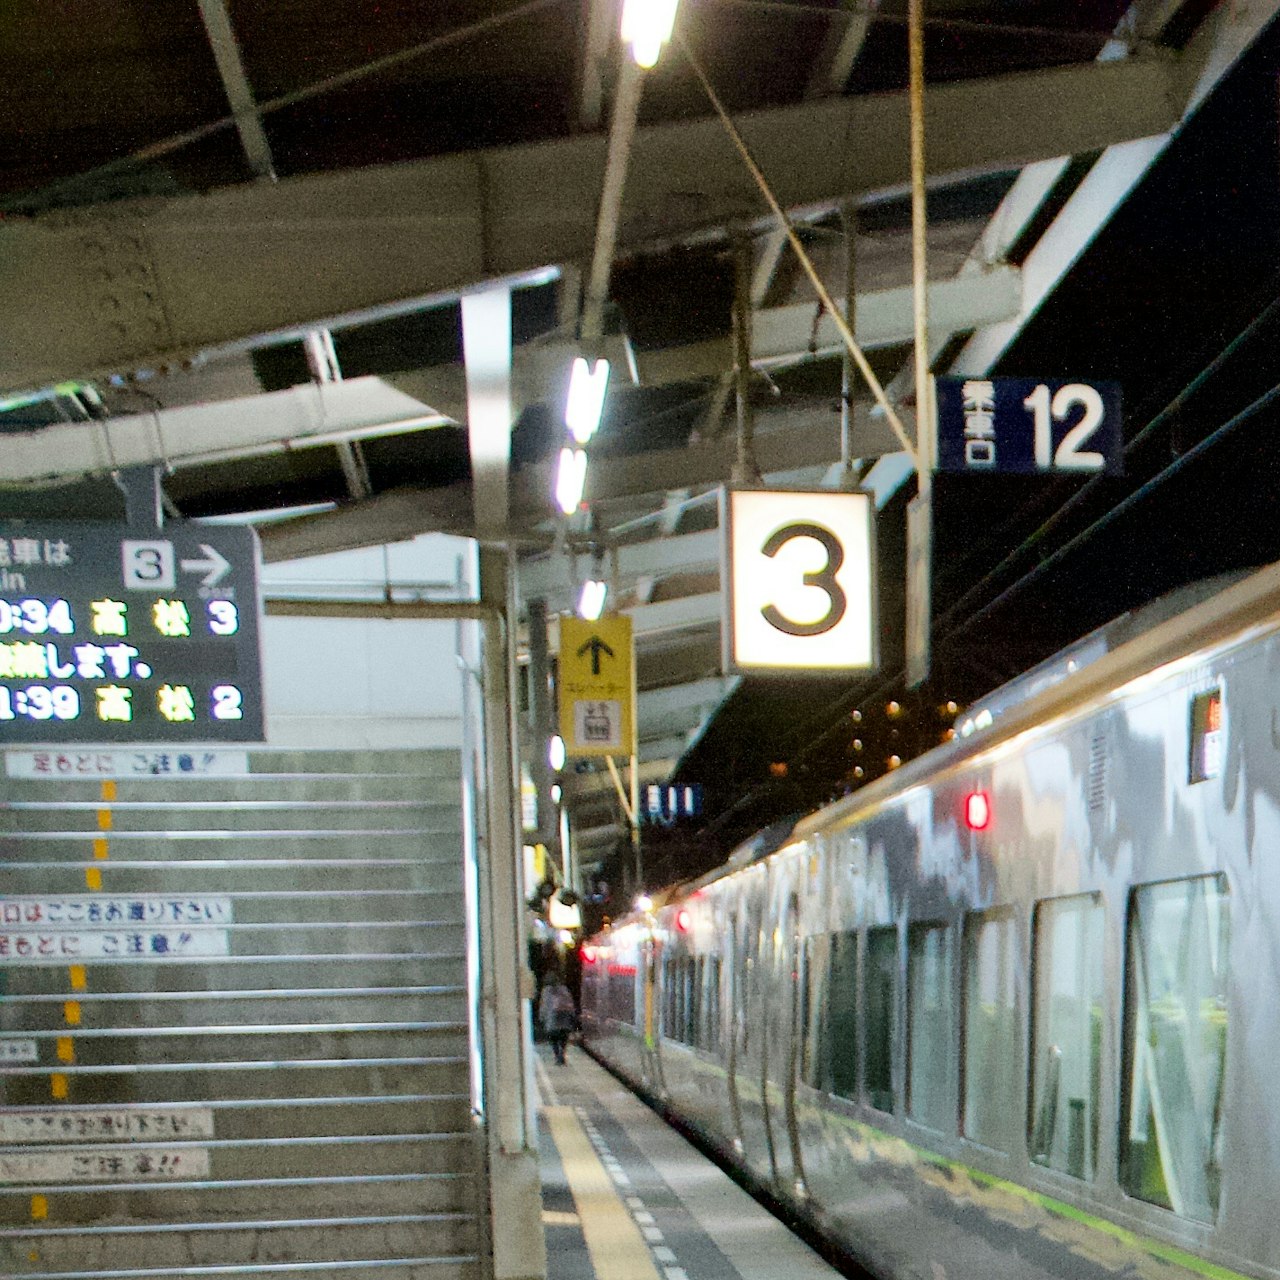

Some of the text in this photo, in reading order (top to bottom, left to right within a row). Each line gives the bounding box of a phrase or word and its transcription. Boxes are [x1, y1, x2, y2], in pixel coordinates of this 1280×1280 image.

[962, 381, 1106, 468] 乗車口 12
[134, 548, 163, 581] 3
[761, 523, 847, 637] 3
[206, 599, 239, 636] 3
[211, 684, 243, 721] 2
